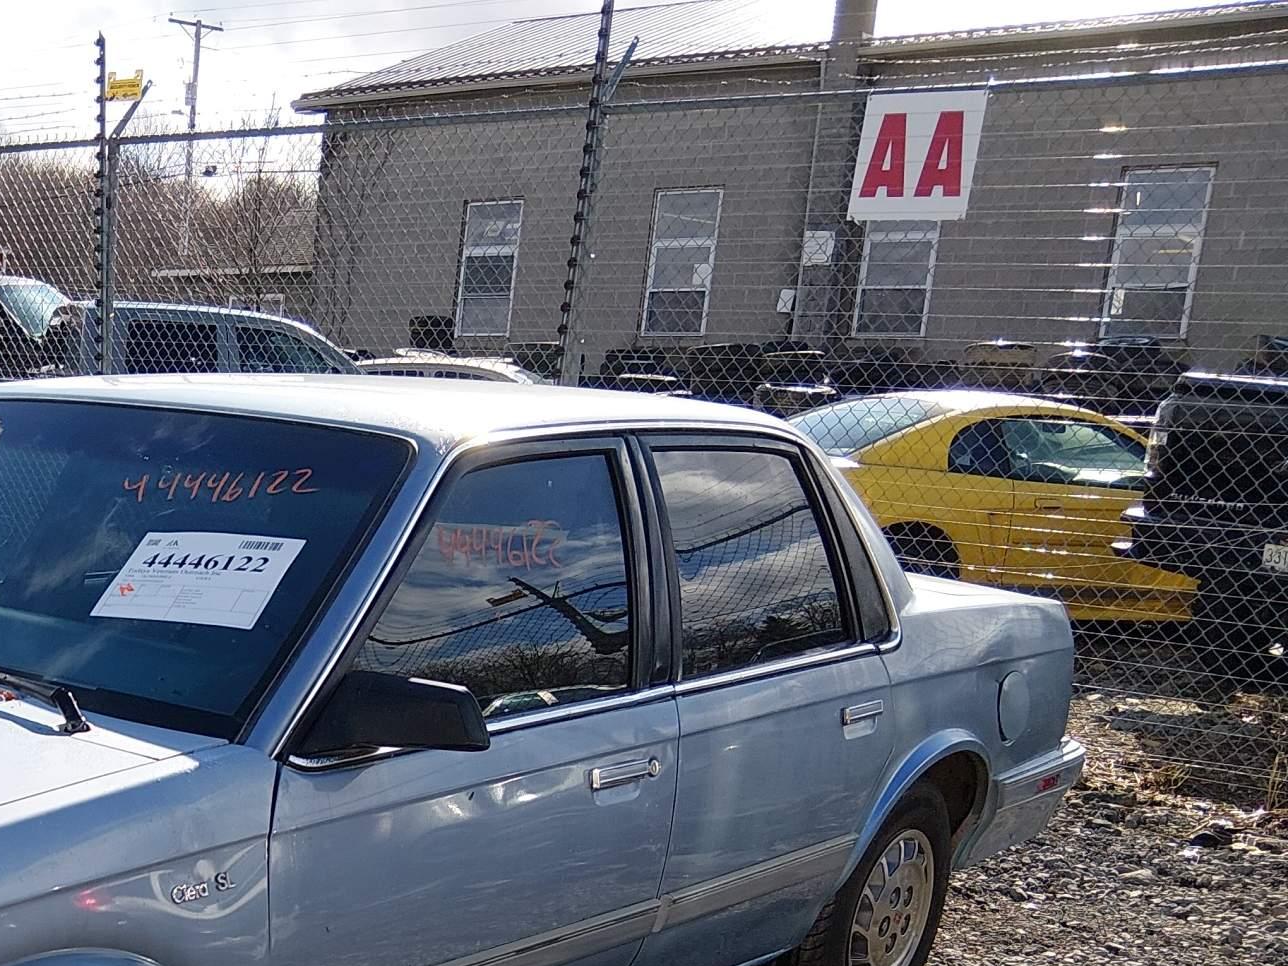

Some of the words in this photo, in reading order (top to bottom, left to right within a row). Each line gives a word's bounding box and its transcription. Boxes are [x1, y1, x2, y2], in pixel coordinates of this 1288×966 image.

[859, 111, 964, 198] AA
[122, 467, 321, 504] 44446122
[142, 552, 270, 573] 44446122
[171, 881, 209, 905] Ciera
[215, 871, 236, 892] SL
